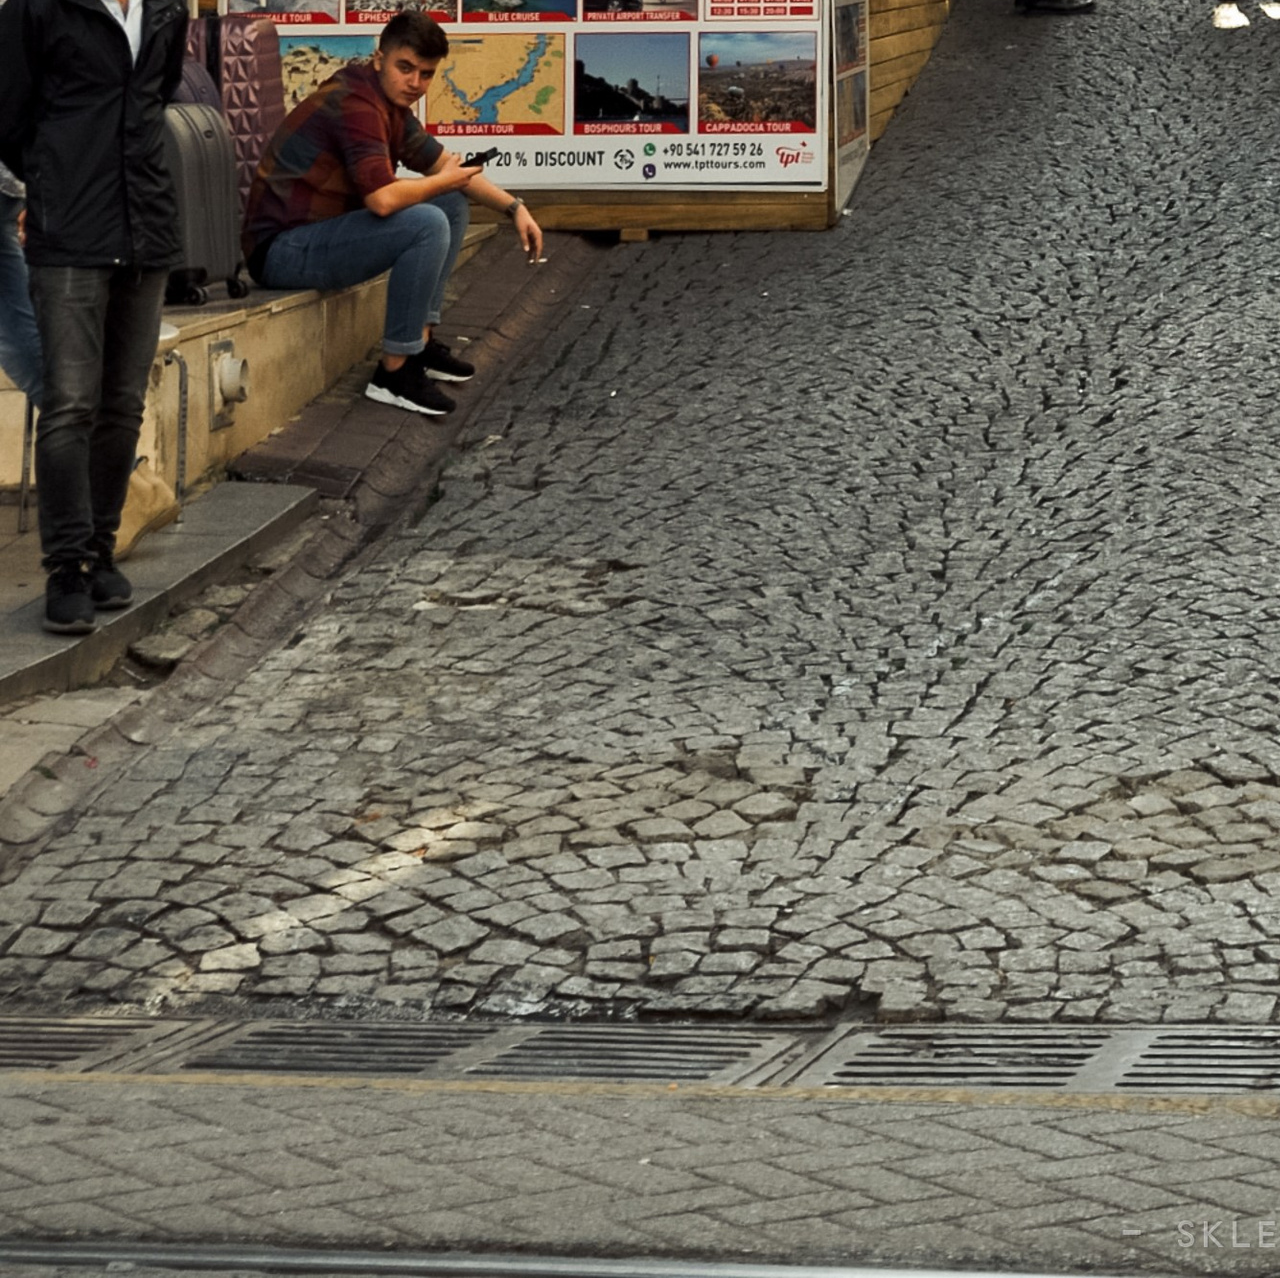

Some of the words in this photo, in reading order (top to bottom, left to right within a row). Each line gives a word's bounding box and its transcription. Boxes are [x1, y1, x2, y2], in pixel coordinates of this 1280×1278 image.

[289, 13, 312, 22] TOUR
[488, 13, 509, 22] BLUE
[511, 12, 540, 21] CRUISE
[587, 12, 616, 21] PRIVATE
[617, 12, 645, 21] AIRPORT
[646, 12, 680, 20] TRANSFER
[437, 125, 456, 134] BUS
[457, 125, 463, 134] &
[465, 125, 489, 134] BOAT
[490, 125, 514, 133] TOUR
[584, 124, 637, 133] BOSPHOURS
[638, 123, 662, 132] TOUR
[705, 123, 764, 132] CAPPADOCIA
[767, 122, 791, 132] TOUR
[663, 144, 683, 157] +90
[686, 144, 706, 156] 541
[709, 143, 730, 156] 727
[733, 143, 748, 156] 59
[750, 143, 763, 156] 26
[496, 152, 511, 167] 20
[516, 152, 527, 166] %
[535, 151, 605, 166] DISCOUNT
[663, 158, 766, 170] www.tpttours.com
